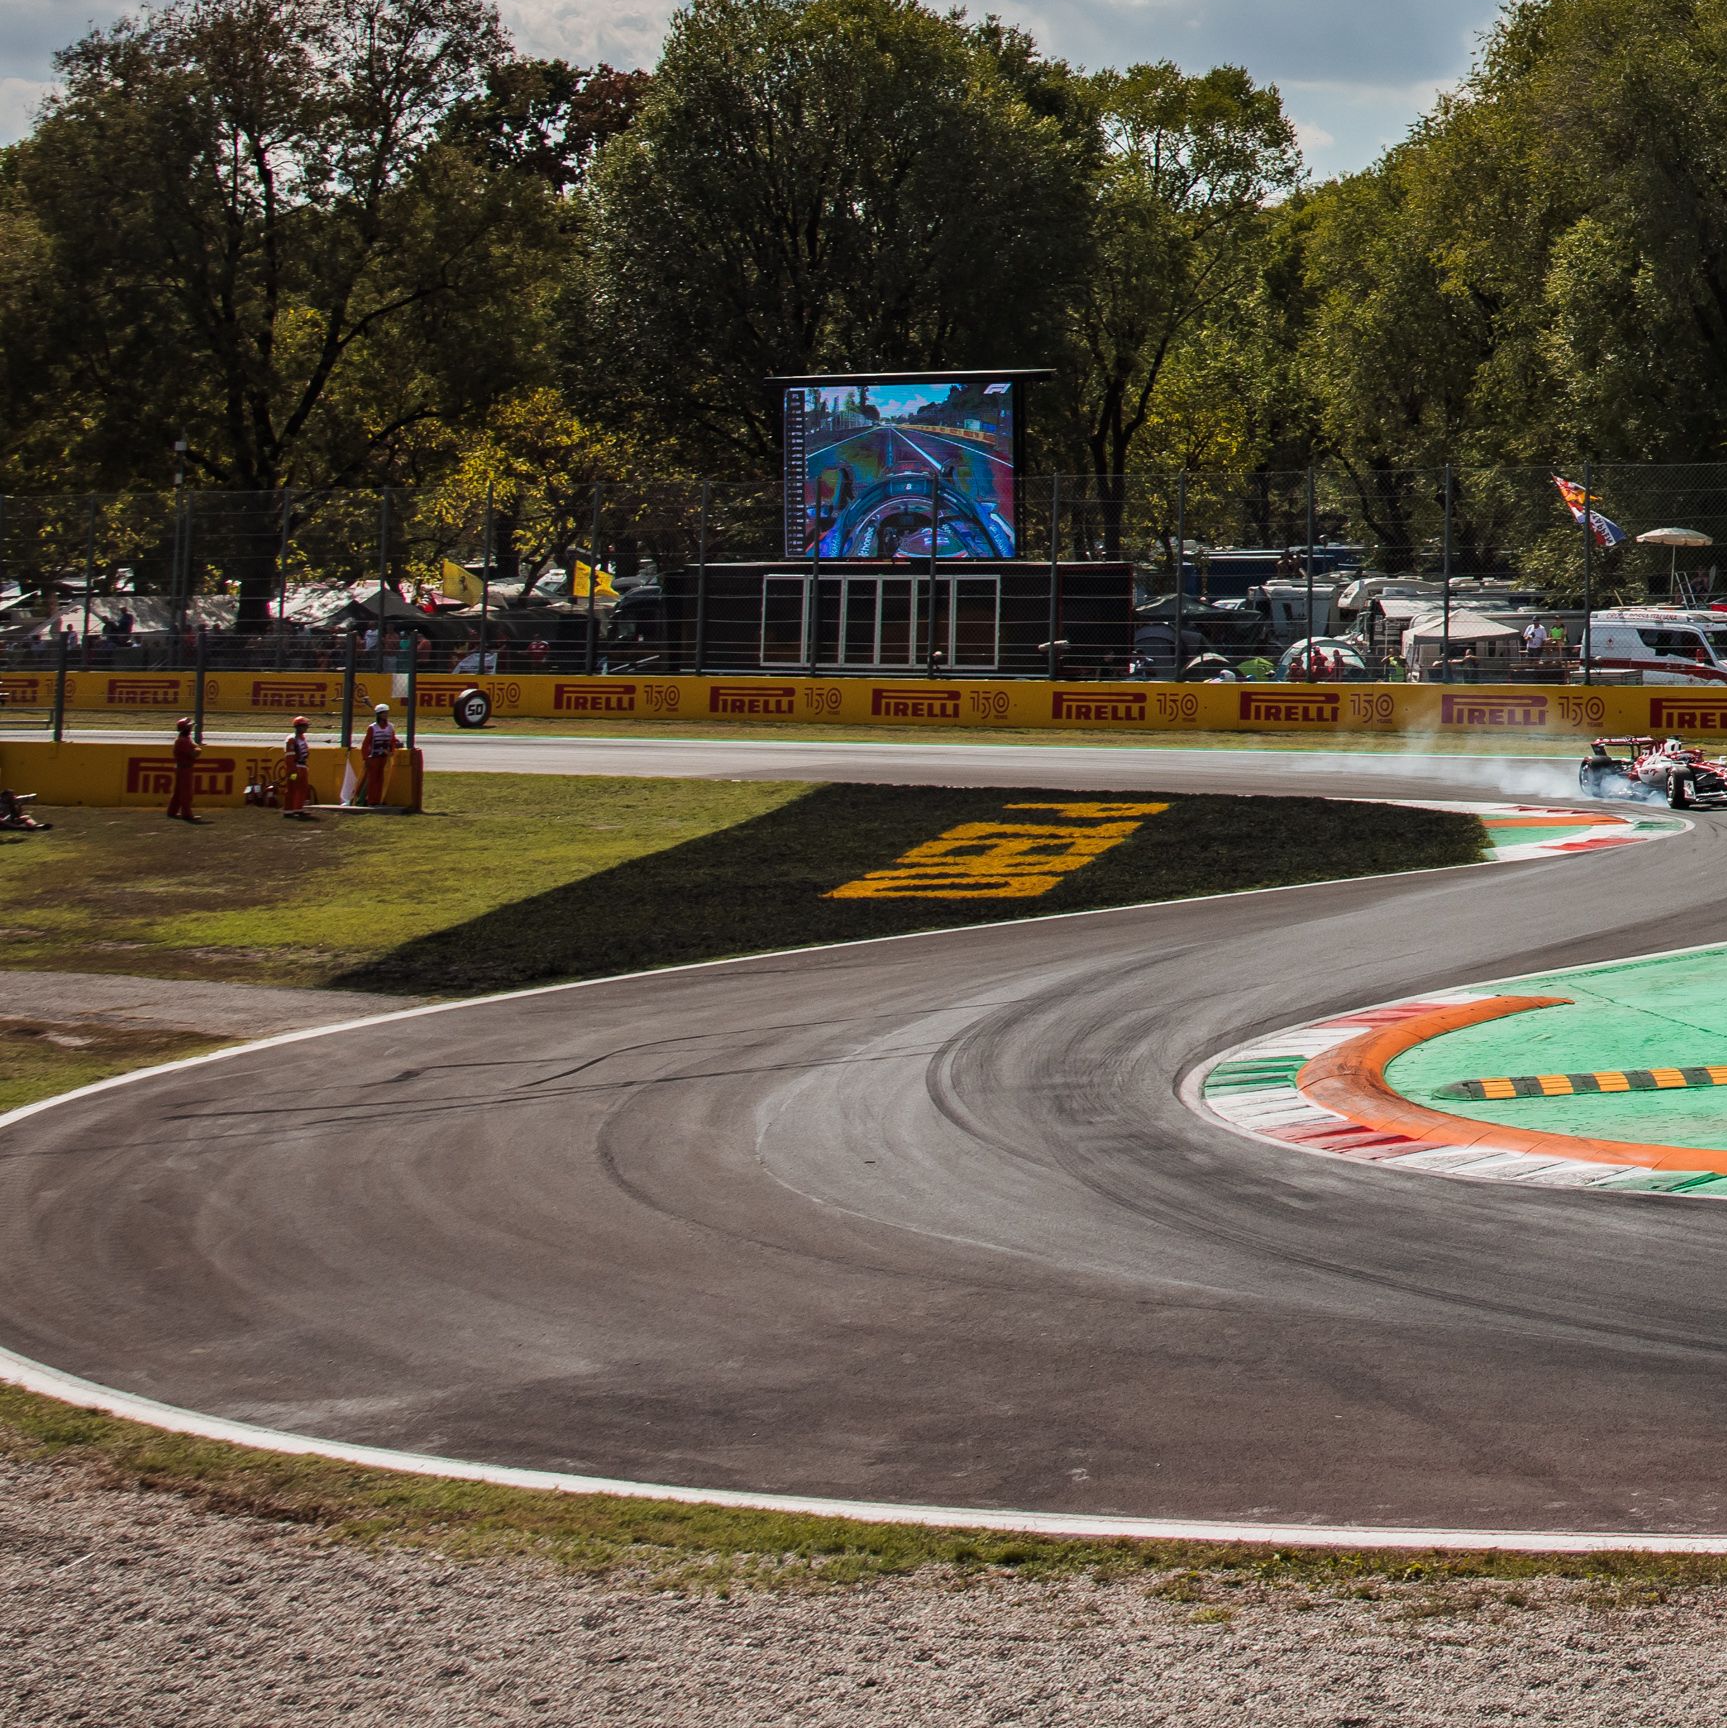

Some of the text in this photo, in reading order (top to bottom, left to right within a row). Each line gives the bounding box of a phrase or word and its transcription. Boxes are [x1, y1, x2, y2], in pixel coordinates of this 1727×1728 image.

[107, 679, 180, 704] PIRELLI
[251, 681, 327, 707] PIRELLI
[554, 684, 680, 711] PIRELLI 150
[710, 686, 842, 715] PIRELLI 150
[872, 689, 1009, 719] PIRELLI 150
[1052, 691, 1198, 721] PIRELLI 150
[466, 702, 484, 715] 50
[1240, 691, 1394, 722] PIRELLI 150
[1442, 694, 1605, 726] PIRELLI 150
[127, 758, 236, 794] PIRLLI
